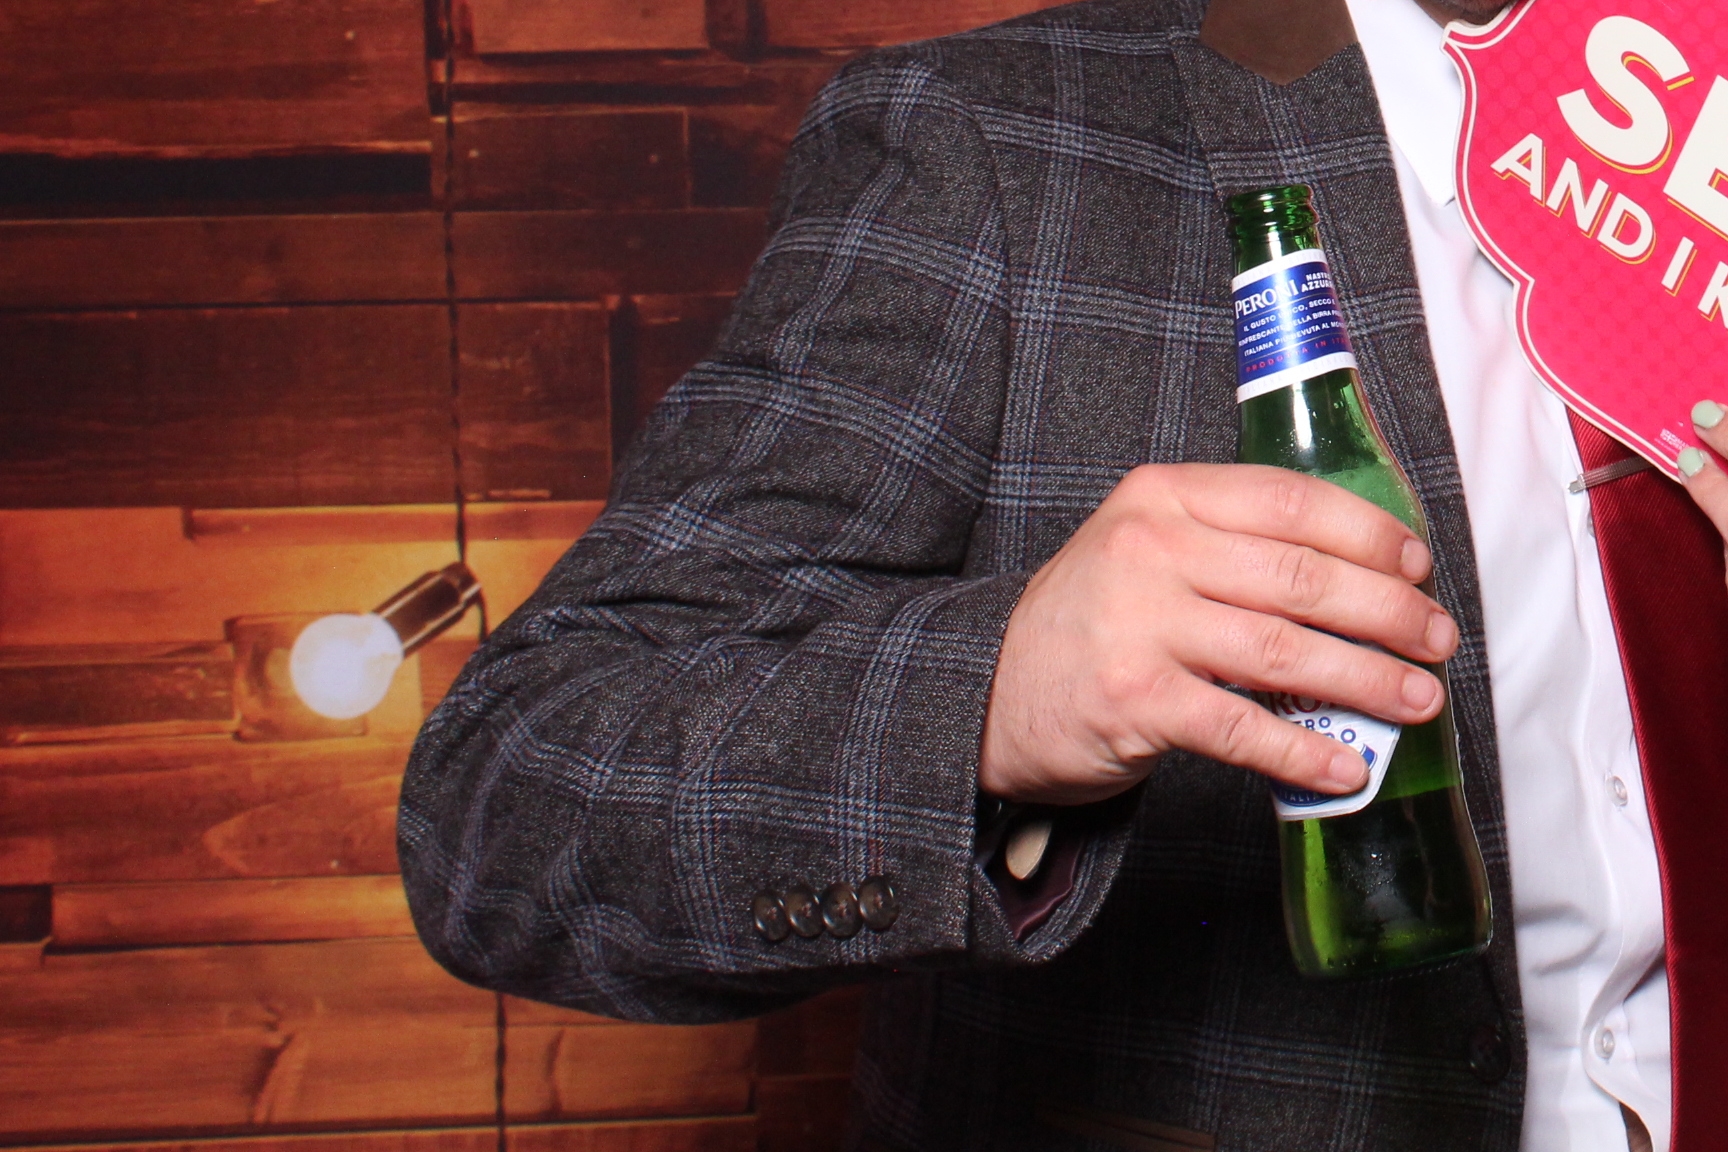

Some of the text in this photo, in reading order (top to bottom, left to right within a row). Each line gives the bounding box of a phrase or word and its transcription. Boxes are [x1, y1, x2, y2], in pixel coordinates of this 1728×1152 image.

[1491, 133, 1656, 265] AND
[1661, 236, 1698, 295] I
[1235, 279, 1300, 319] PERONI
[1250, 314, 1277, 329] GUSTO
[1308, 298, 1332, 308] SECCO
[1244, 340, 1275, 357] ITALIANA
[1321, 322, 1330, 330] AL
